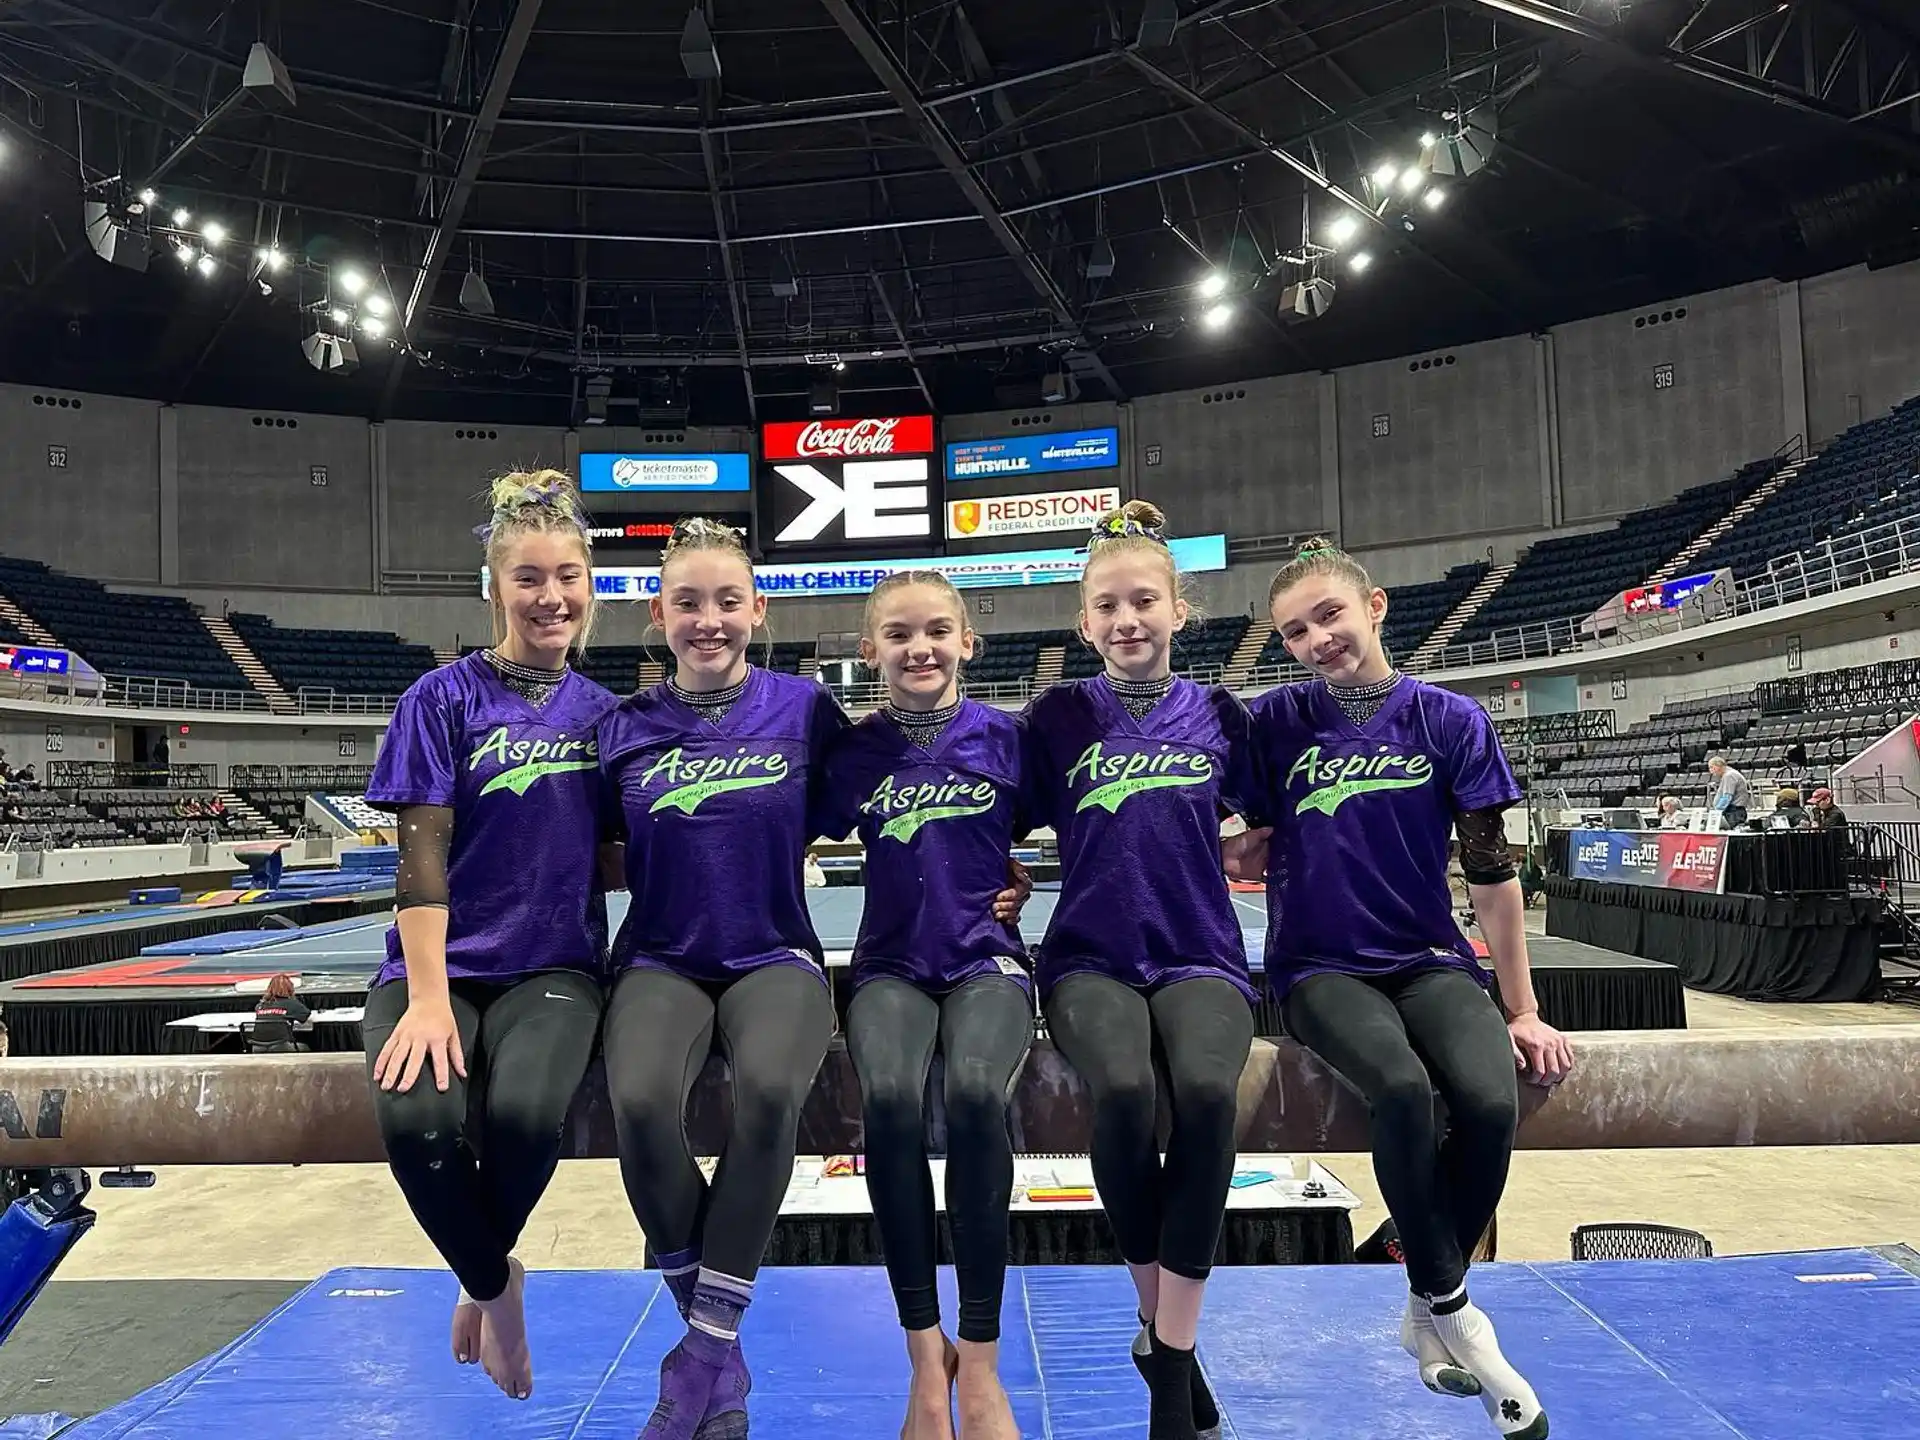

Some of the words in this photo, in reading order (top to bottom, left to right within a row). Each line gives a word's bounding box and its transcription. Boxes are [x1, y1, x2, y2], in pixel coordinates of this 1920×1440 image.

[1655, 371, 1672, 388] 319
[796, 418, 900, 456] Coca-Cola
[1374, 421, 1388, 436] 318
[49, 452, 66, 467] 312
[642, 462, 709, 474] ticketmaster
[312, 472, 327, 485] 313
[987, 493, 1113, 521] REDSTONE
[626, 524, 673, 537] CHRIS
[988, 521, 1034, 532] FEDERAL
[1037, 516, 1075, 529] CREDIT
[1023, 562, 1087, 572] AREN
[634, 576, 661, 594] TO
[754, 573, 795, 591] AUN
[47, 733, 63, 750] 209
[340, 741, 355, 755] 210
[469, 727, 598, 771] Aspire
[641, 747, 788, 788] Aspire
[1065, 742, 1212, 789] Aspire
[1285, 745, 1433, 790] Aspire
[860, 775, 996, 814] Aspire
[1621, 843, 1660, 867] ELEVATE
